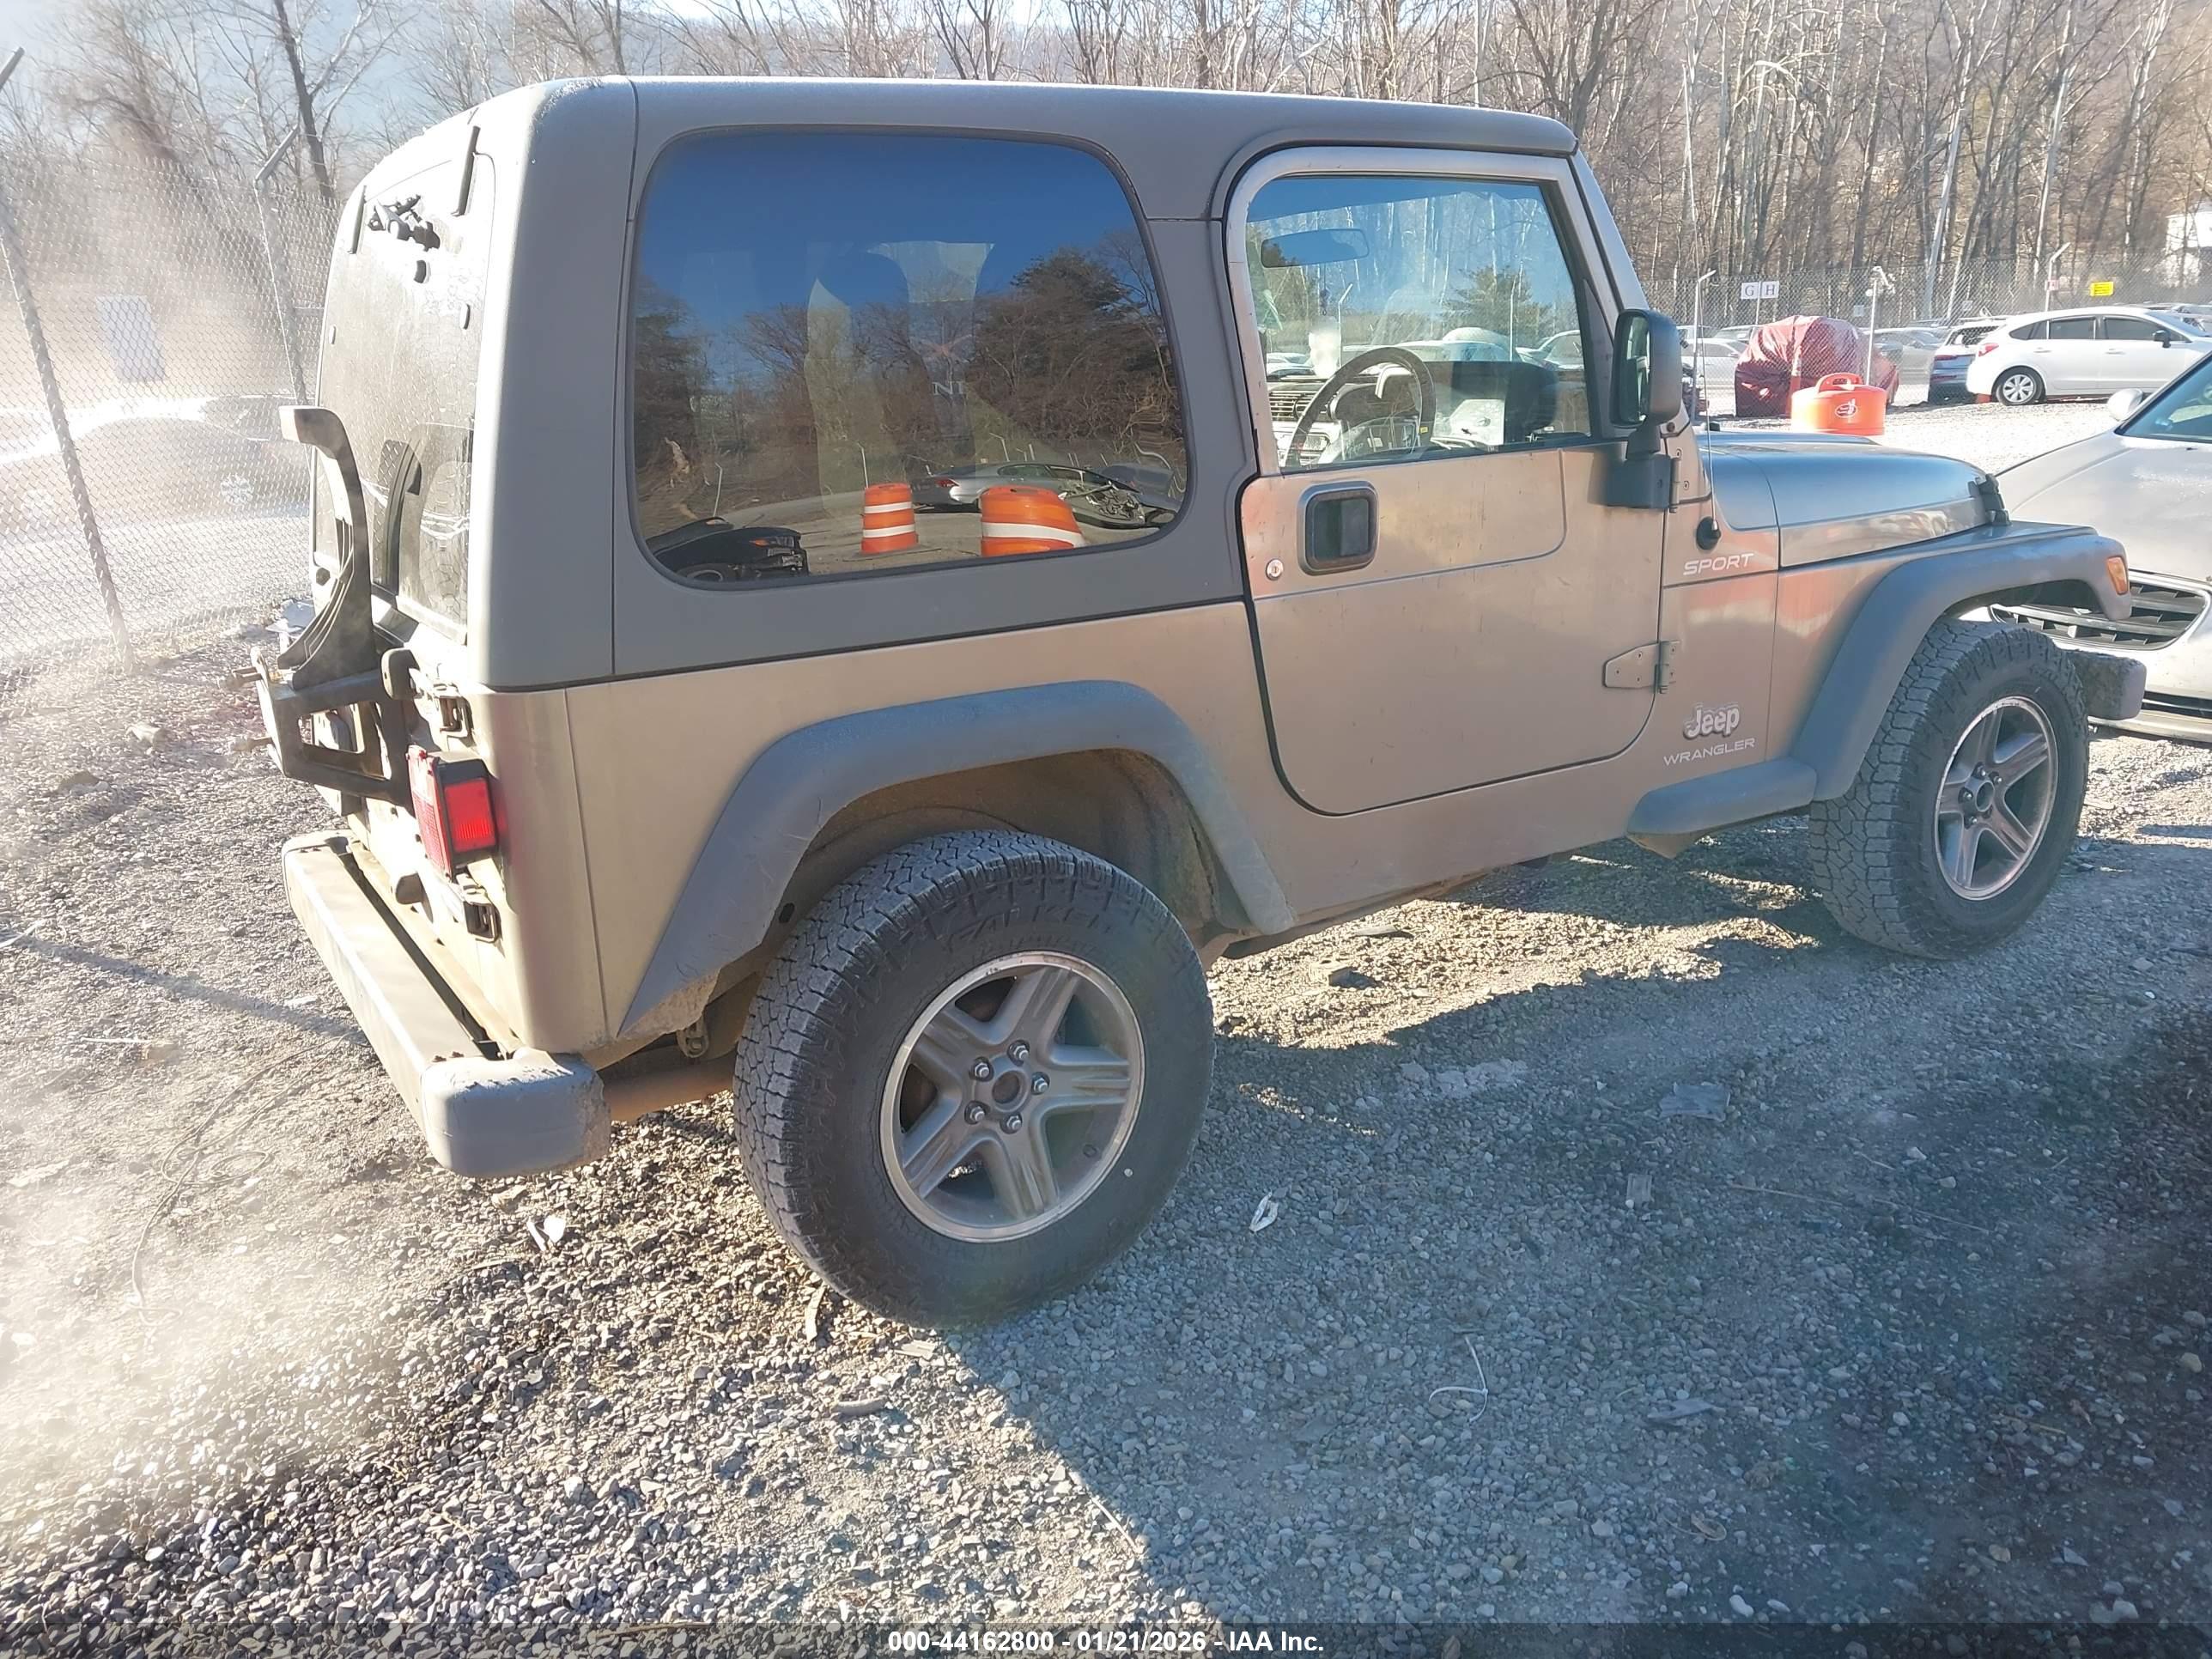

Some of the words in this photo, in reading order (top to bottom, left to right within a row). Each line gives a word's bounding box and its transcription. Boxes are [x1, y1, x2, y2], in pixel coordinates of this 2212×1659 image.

[1745, 285, 1755, 297] G
[1765, 284, 1776, 296] H
[1683, 552, 1753, 575] SPORT
[1683, 702, 1740, 738] Jeep
[1662, 738, 1755, 766] WRANGLER
